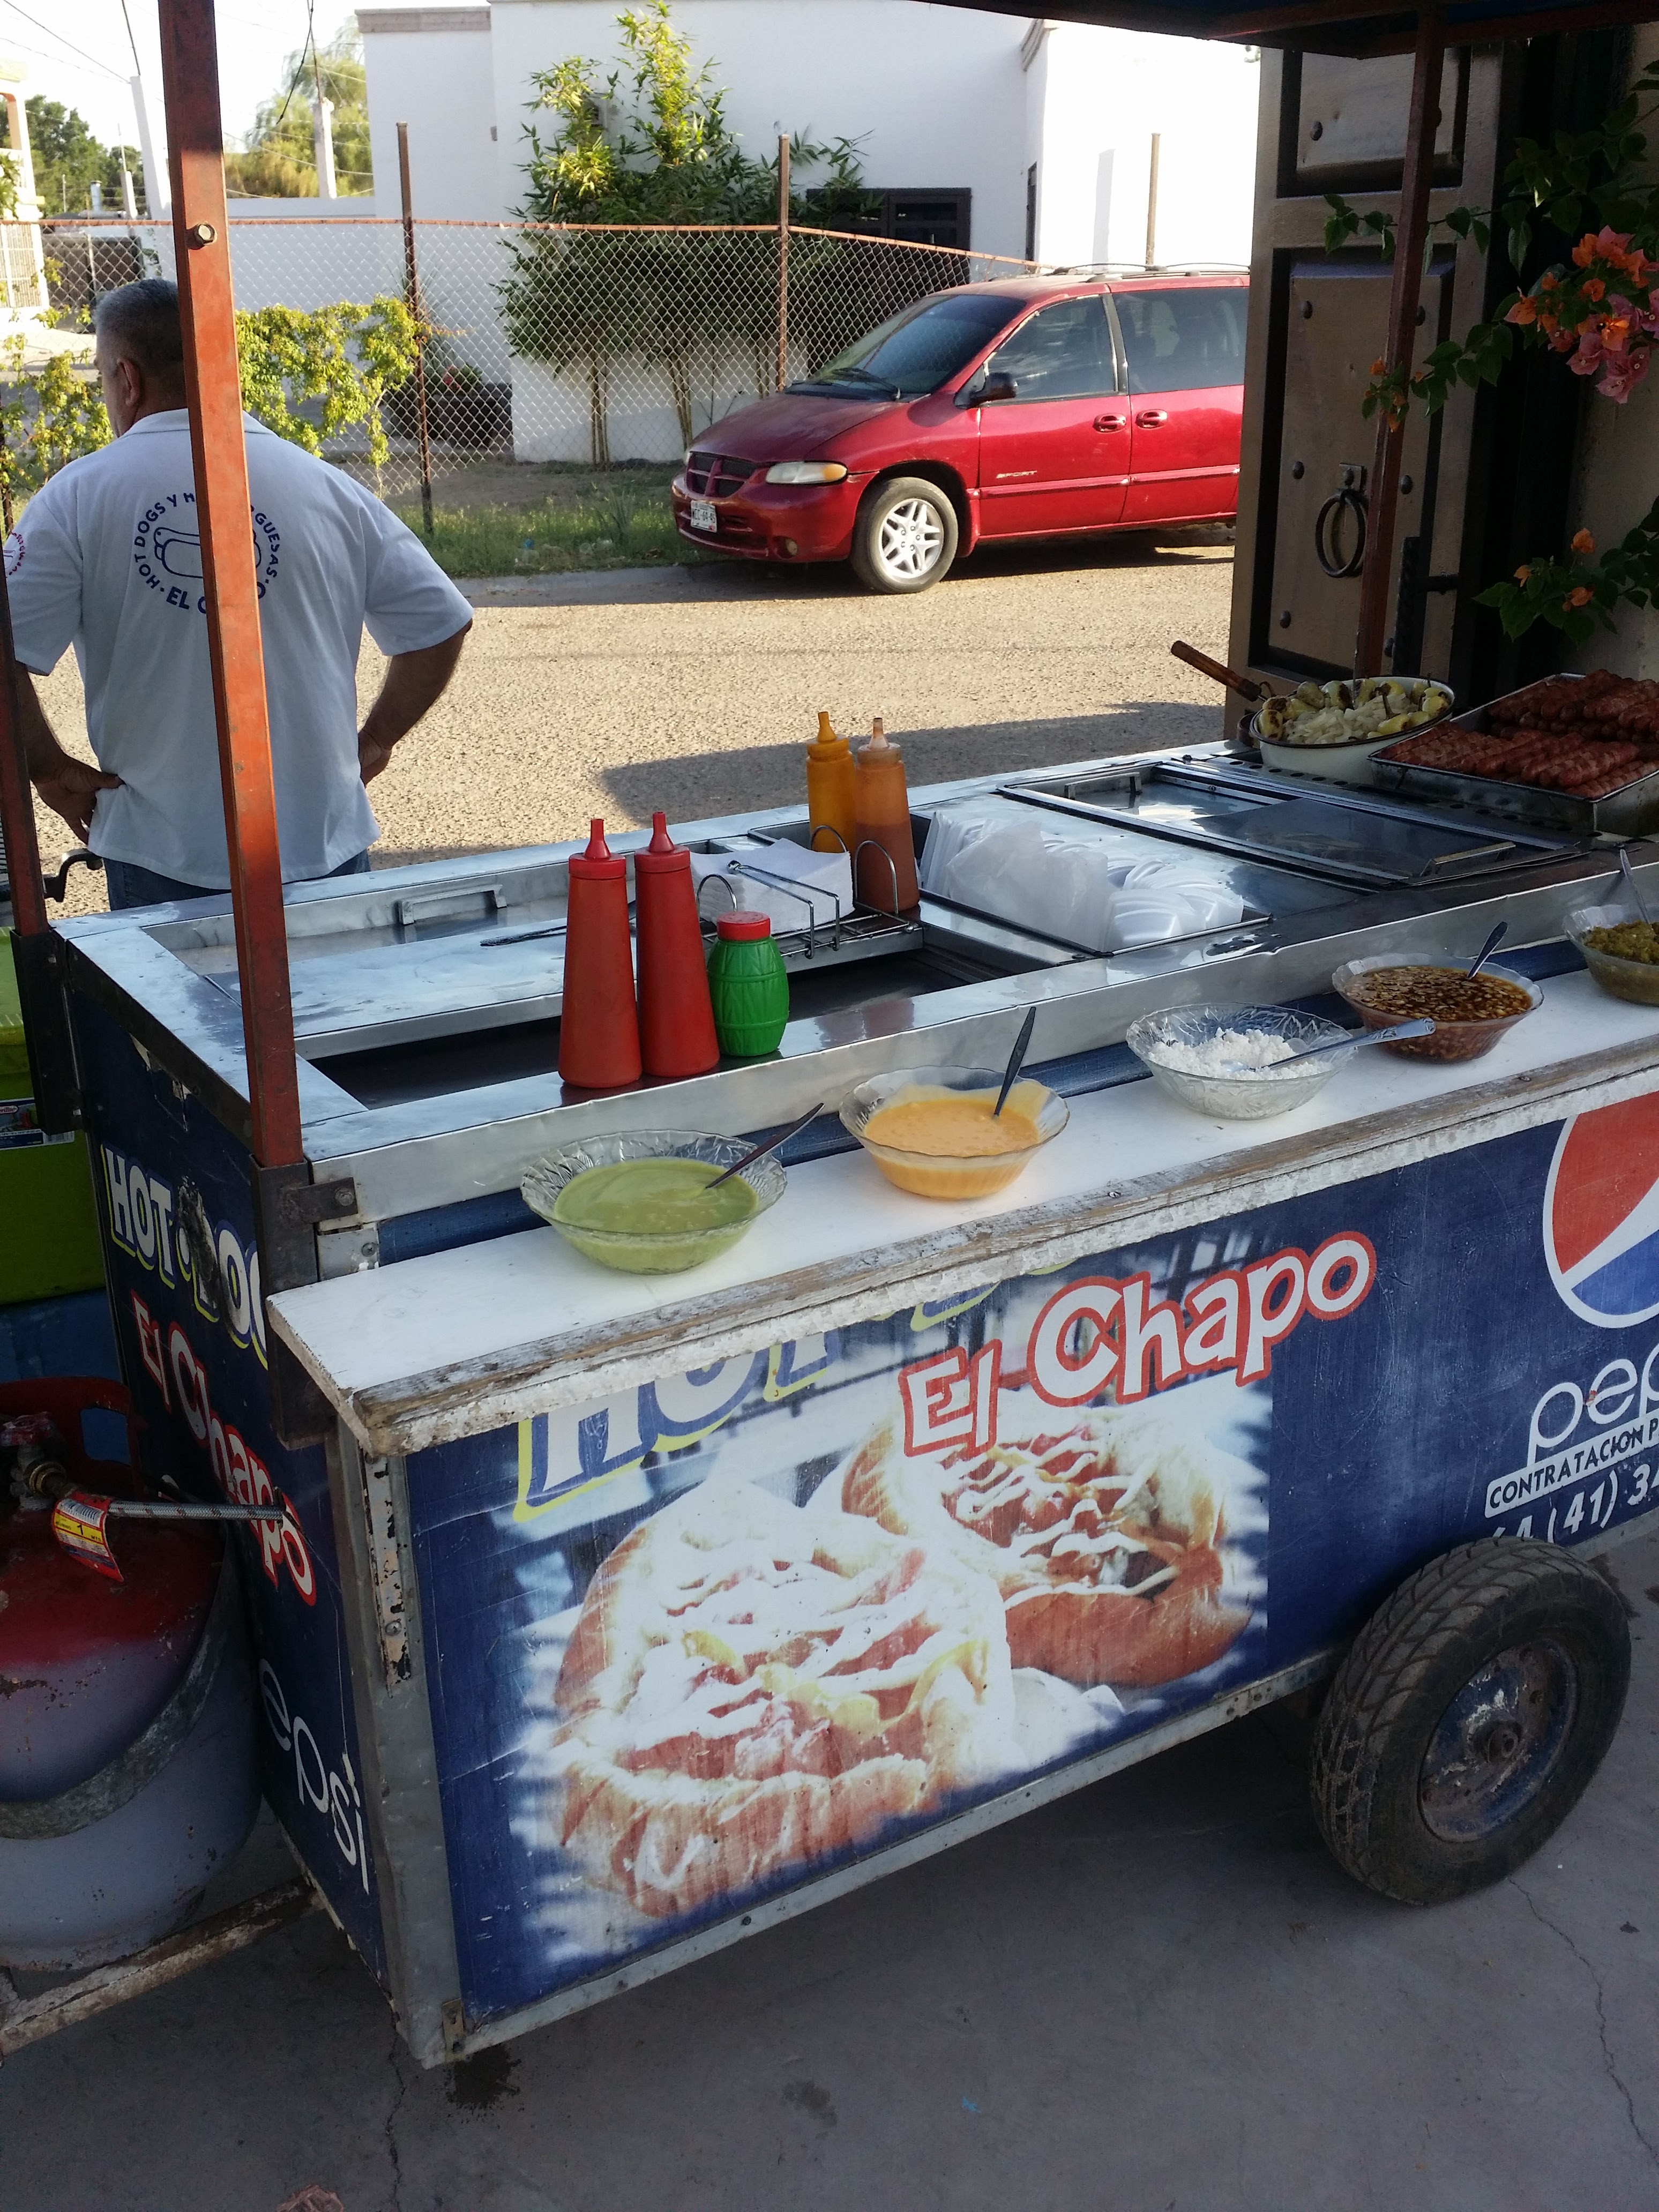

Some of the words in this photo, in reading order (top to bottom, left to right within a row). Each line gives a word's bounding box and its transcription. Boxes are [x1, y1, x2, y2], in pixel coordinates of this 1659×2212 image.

[134, 502, 166, 548] DOGS
[166, 494, 177, 507] Y
[183, 492, 280, 578] HGUESAS
[134, 554, 160, 589] HOT
[166, 586, 190, 610] EL
[102, 1145, 176, 1286] HOT
[900, 1341, 1000, 1455] El
[1029, 1232, 1376, 1406] Chapo
[132, 1291, 171, 1410] El
[170, 1322, 315, 1602] Chapo
[1489, 1424, 1644, 1509] CONTRATACION
[259, 1658, 369, 1895] epsi
